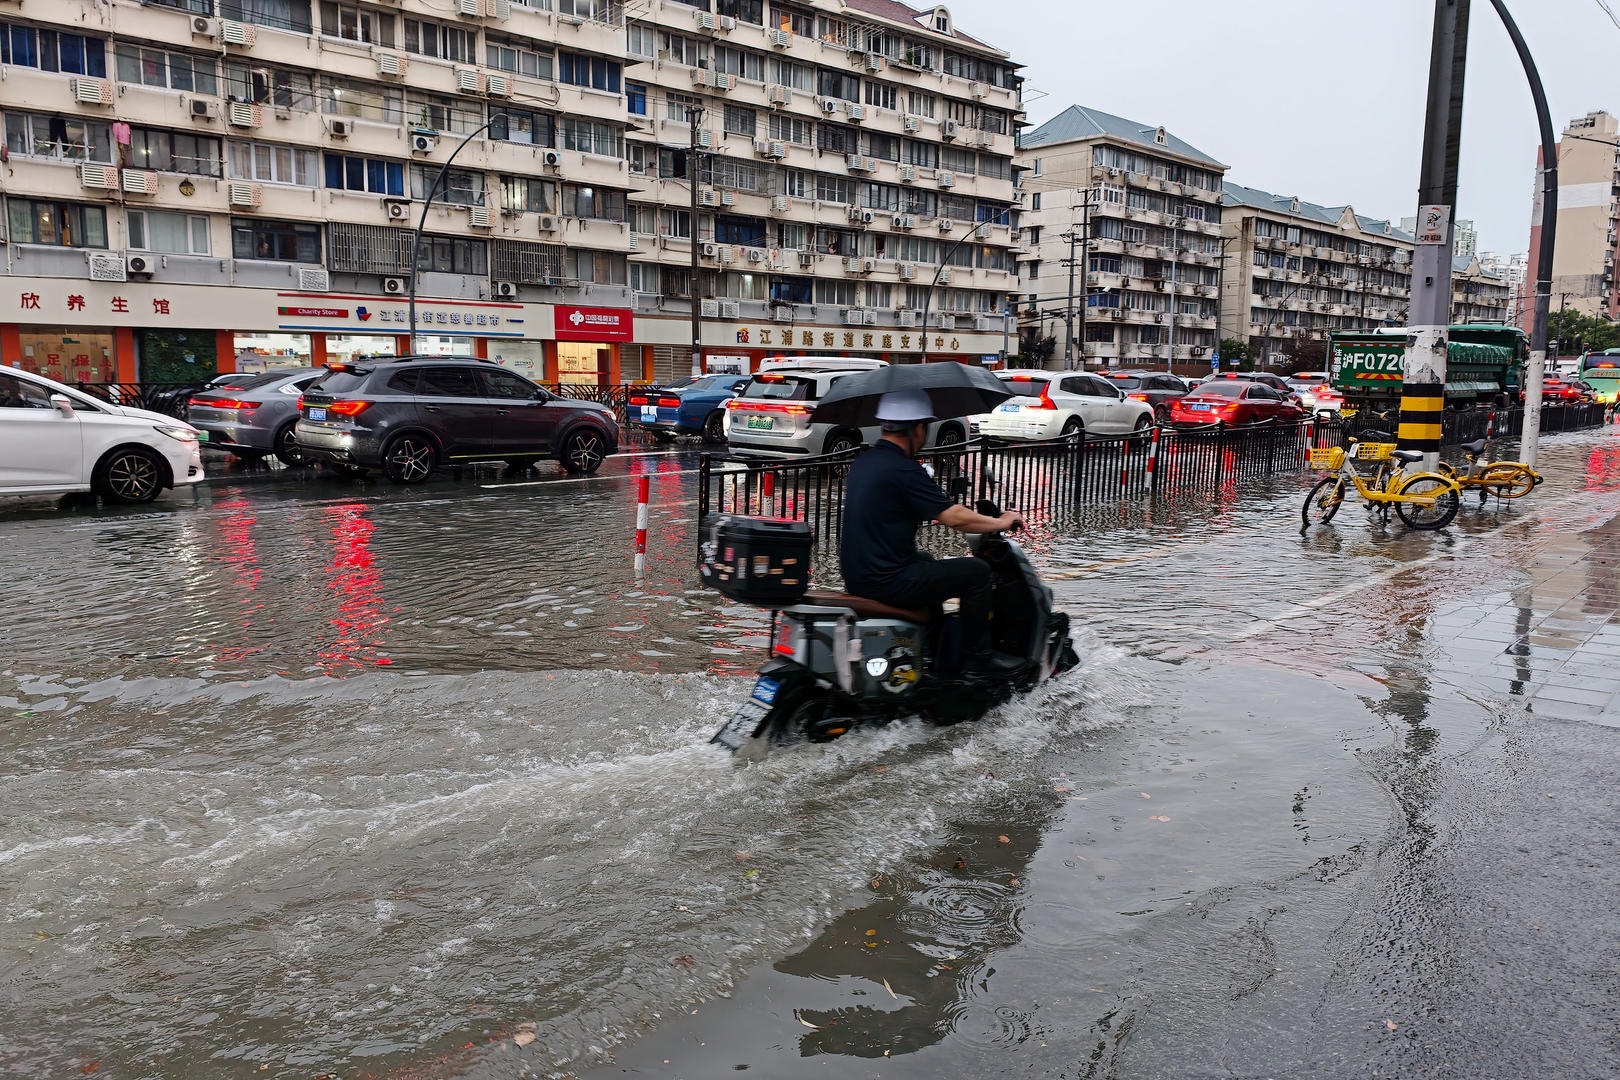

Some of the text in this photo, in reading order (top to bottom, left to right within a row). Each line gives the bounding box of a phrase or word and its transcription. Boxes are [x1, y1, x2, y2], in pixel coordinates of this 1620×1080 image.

[21, 292, 170, 315] 欣养生馆
[298, 308, 321, 316] Charity
[760, 328, 960, 351] 江浦路街道家庭支持中心
